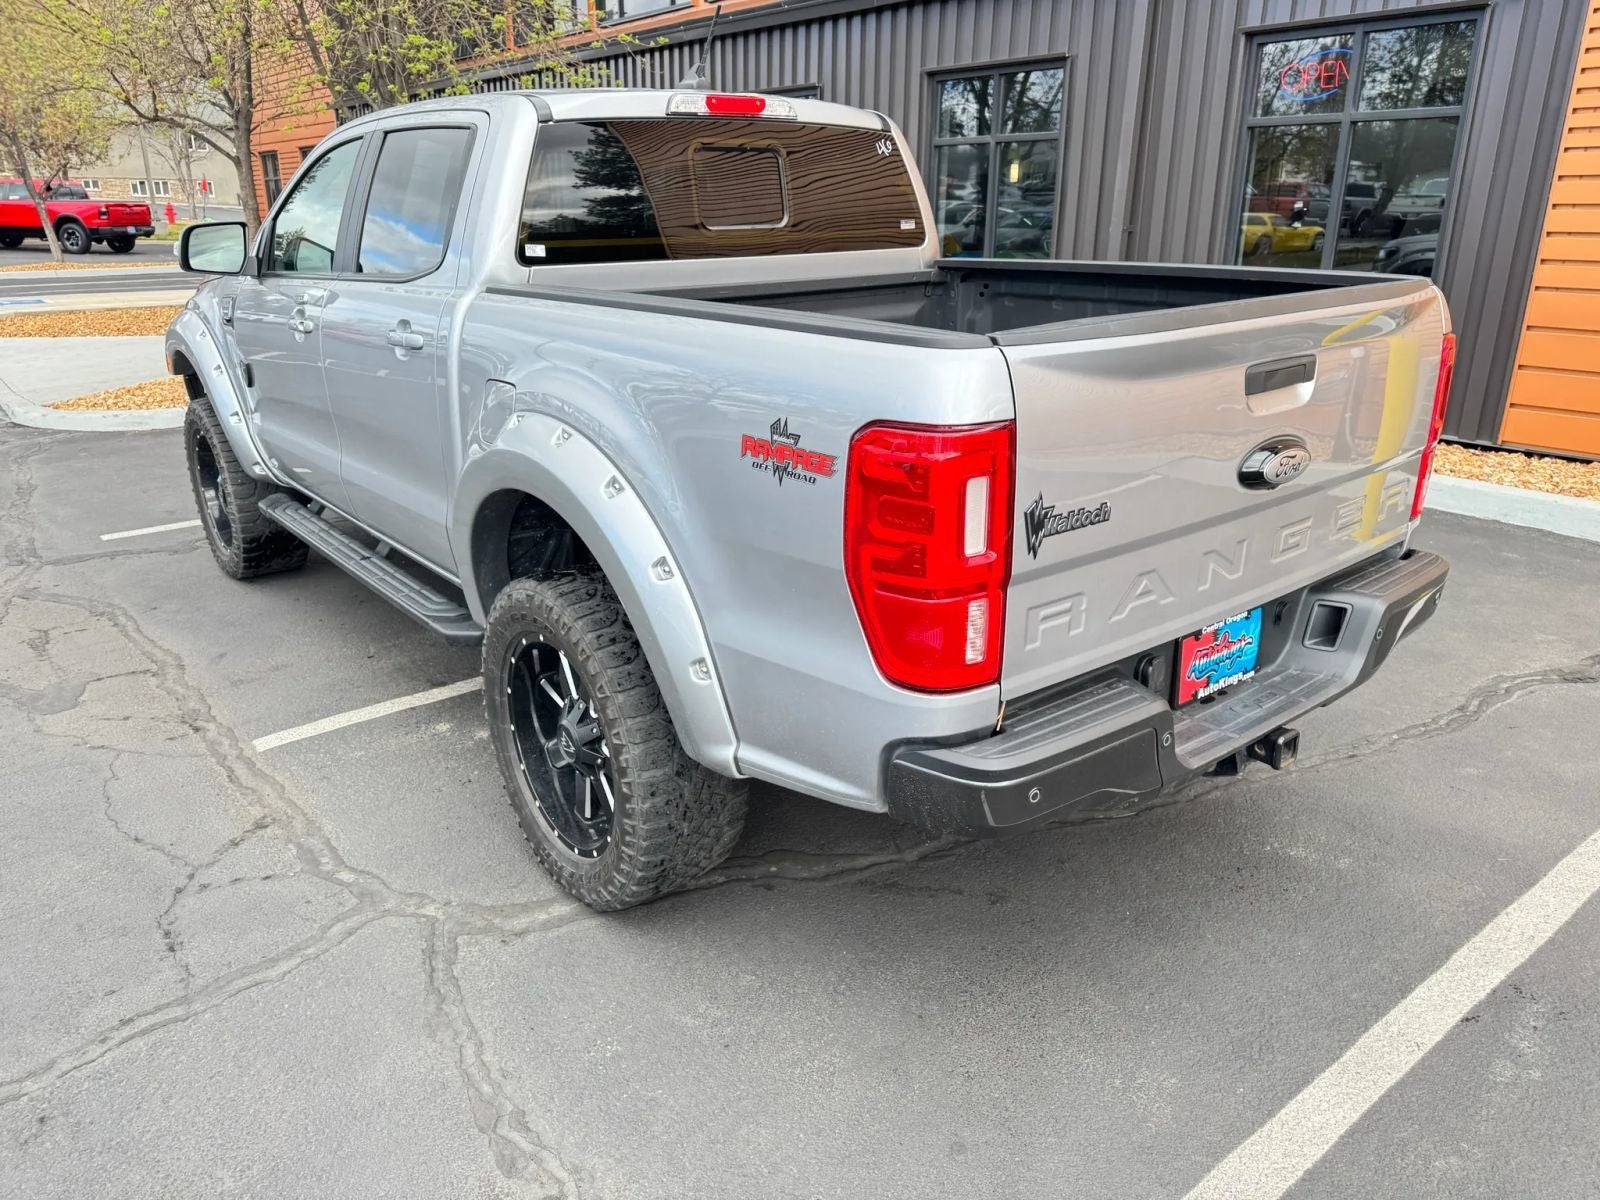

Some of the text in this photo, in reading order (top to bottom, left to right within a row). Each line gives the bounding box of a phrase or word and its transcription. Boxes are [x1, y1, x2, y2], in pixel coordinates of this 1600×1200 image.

[1281, 60, 1350, 91] OPEN
[740, 434, 838, 479] RAMPAGE
[1275, 453, 1305, 478] Ford
[752, 461, 817, 484] OFF ROAD
[1024, 478, 1411, 652] RANGER
[1202, 611, 1248, 634] Central Oregon
